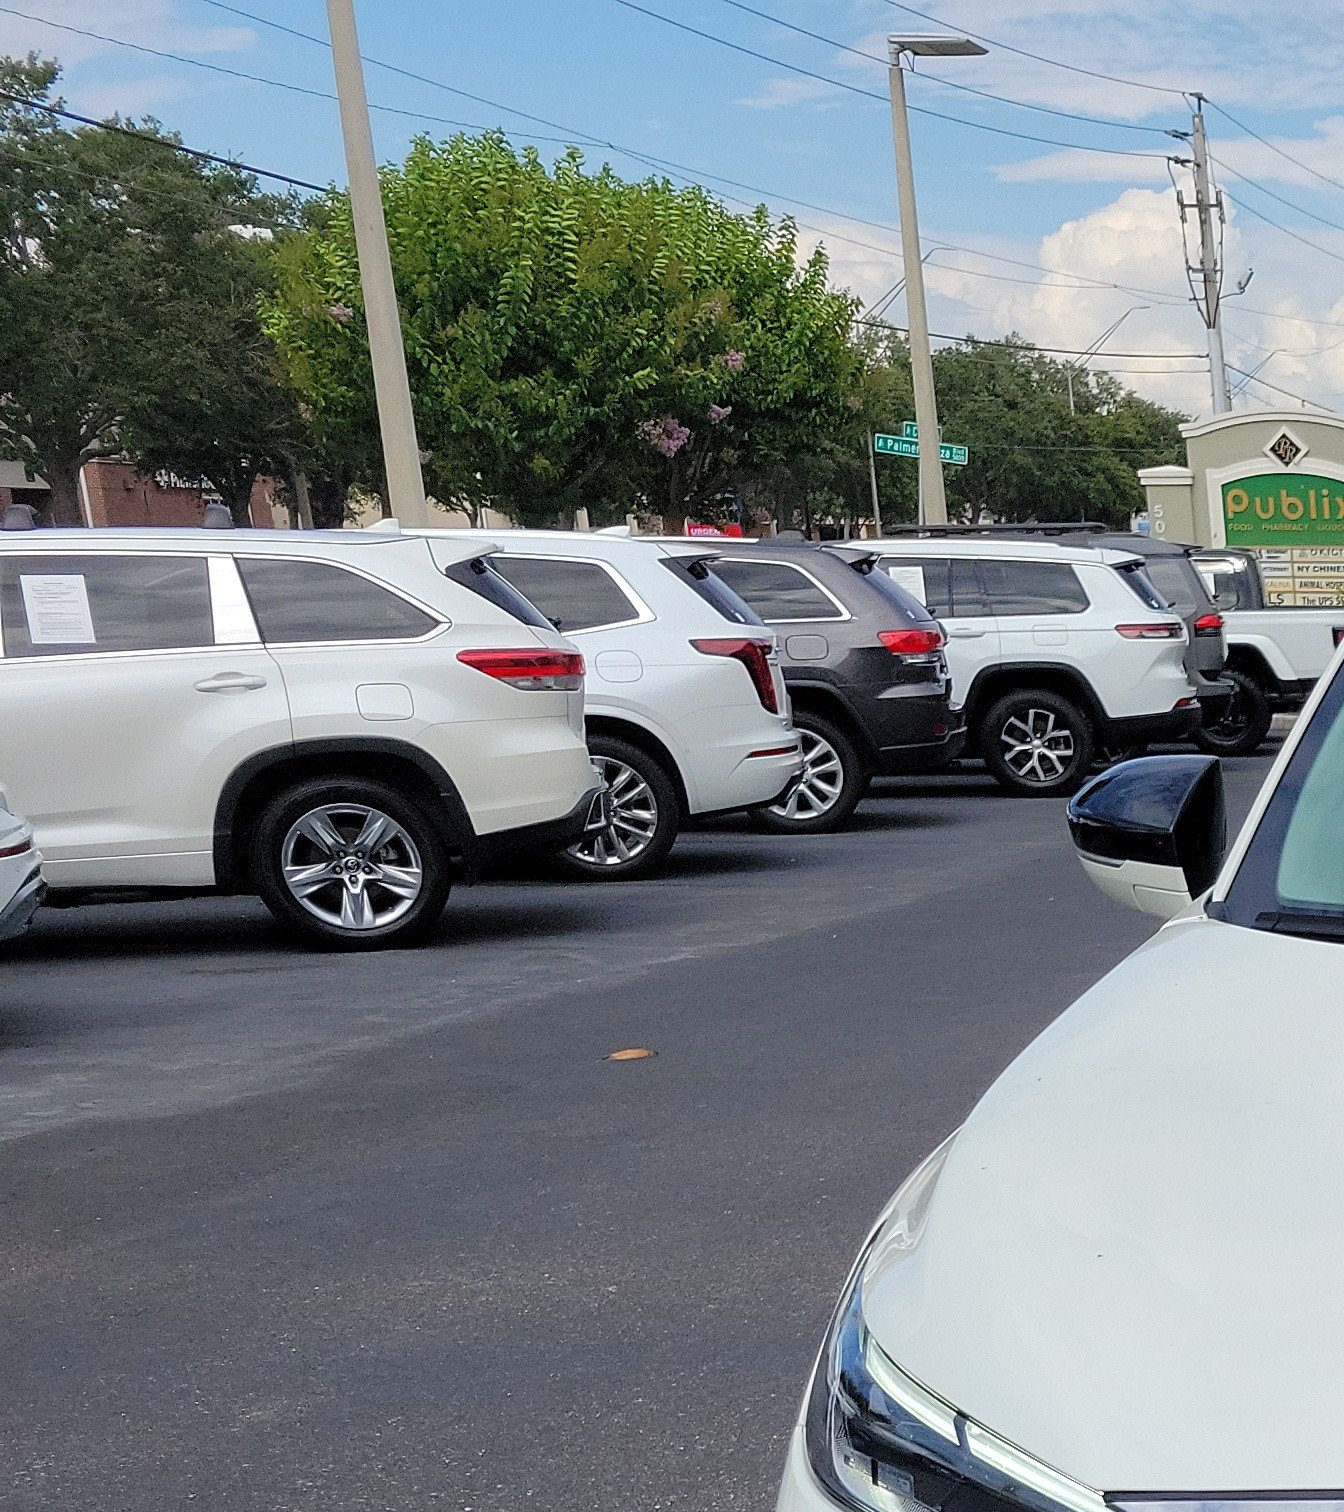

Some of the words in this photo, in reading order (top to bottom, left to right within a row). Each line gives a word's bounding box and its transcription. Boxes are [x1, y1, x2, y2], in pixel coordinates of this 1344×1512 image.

[1228, 523, 1253, 532] FOOD
[1262, 523, 1309, 532] PHARMACY
[1297, 565, 1311, 573] NY
[1302, 596, 1317, 606] The
[1318, 597, 1334, 606] UPS
